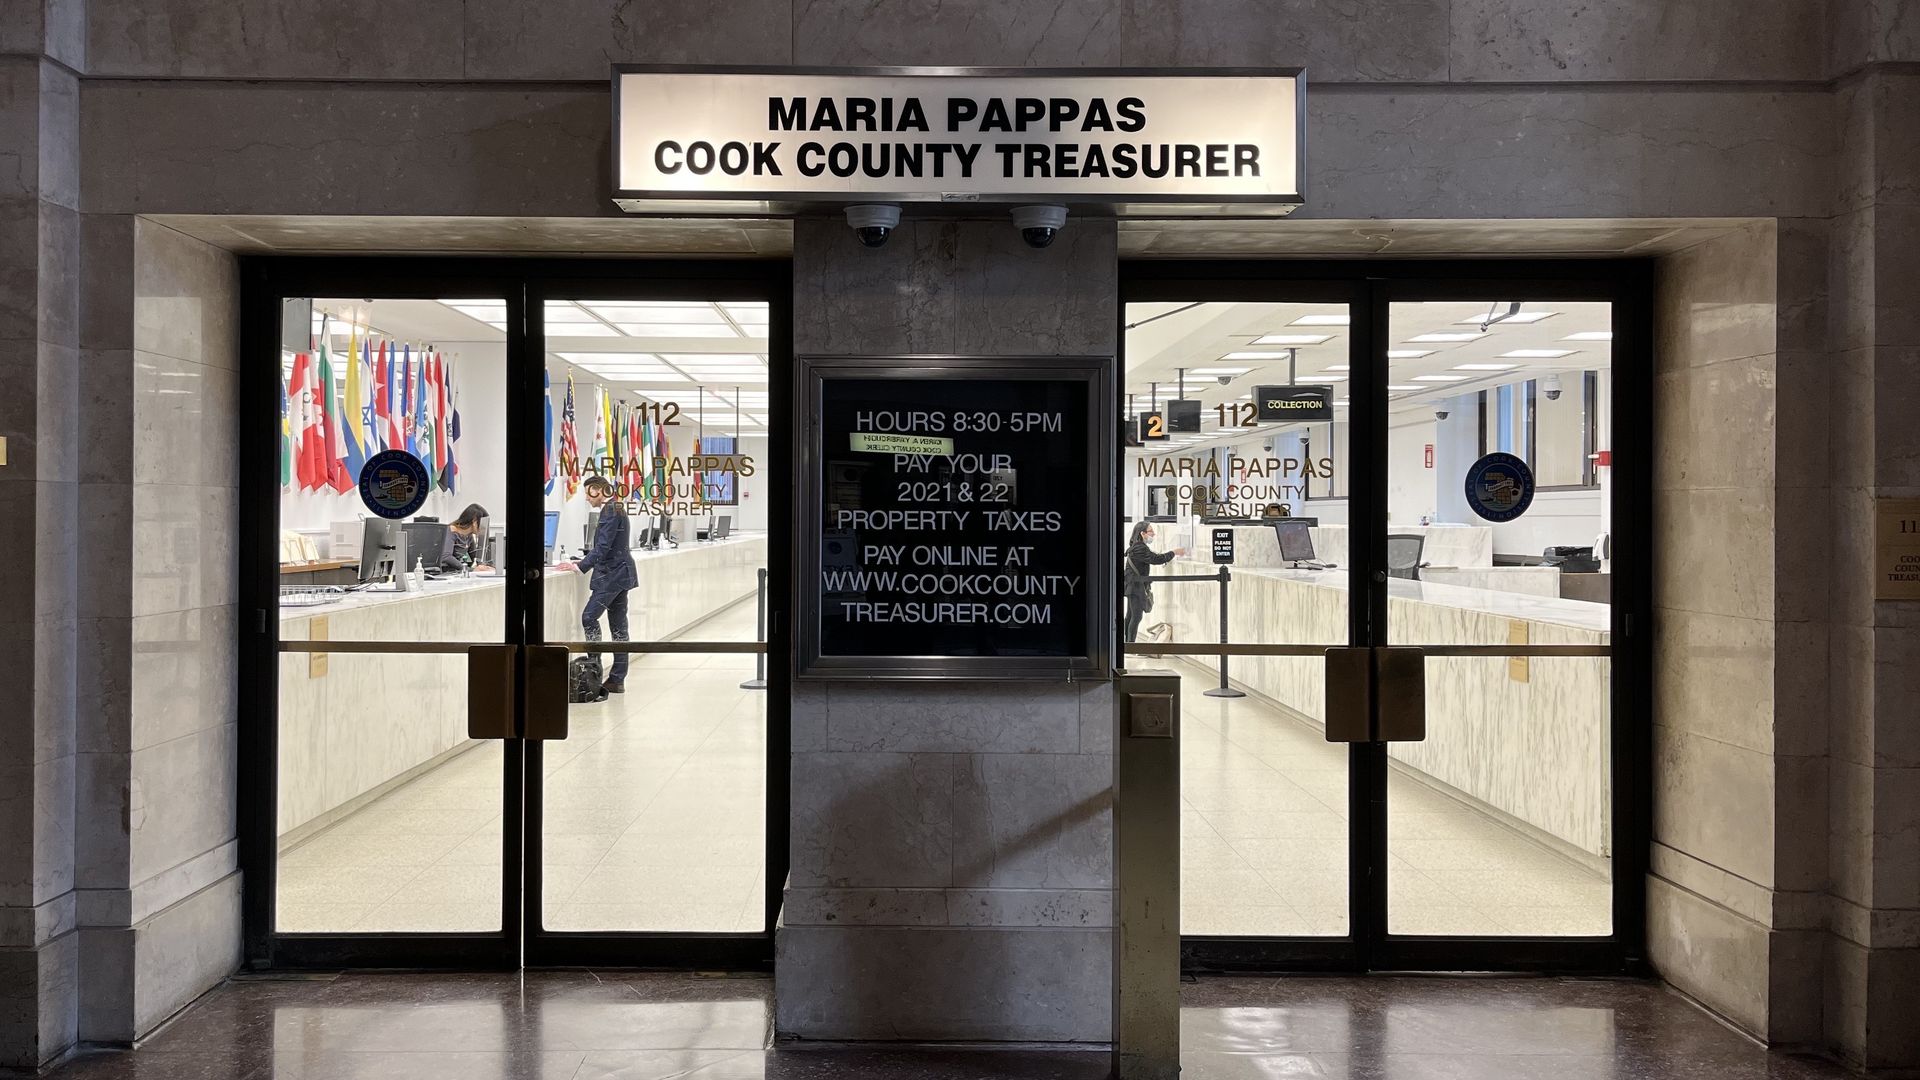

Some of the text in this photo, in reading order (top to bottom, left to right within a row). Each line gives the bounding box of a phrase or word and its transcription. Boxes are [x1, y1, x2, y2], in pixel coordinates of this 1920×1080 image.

[768, 97, 1147, 132] MARIA PAPPAS
[654, 141, 1261, 178] COOK COUNTY TREASURER
[635, 401, 680, 425] 112
[1213, 403, 1258, 427] 112
[1267, 400, 1323, 409] COLLECTION
[857, 411, 945, 432] HOURS
[1147, 416, 1163, 437] 2
[559, 456, 755, 477] MARIA PAPPAS
[894, 454, 1012, 474] PAY YOUR
[1137, 457, 1334, 478] MARIA PAPPAS
[587, 483, 727, 499] COOK COUNTY
[898, 483, 1008, 502] 2021 & 22
[1165, 484, 1305, 500] COOK COUNTY
[601, 502, 714, 516] TREASURER
[838, 510, 1061, 531] PROPERTY TAXES
[1900, 520, 1920, 533] 11
[864, 545, 1034, 566] PAY ONLINE AT
[823, 572, 1081, 595] WWW.COOKCOUNTY
[840, 603, 1051, 624] TREASURER.COM
